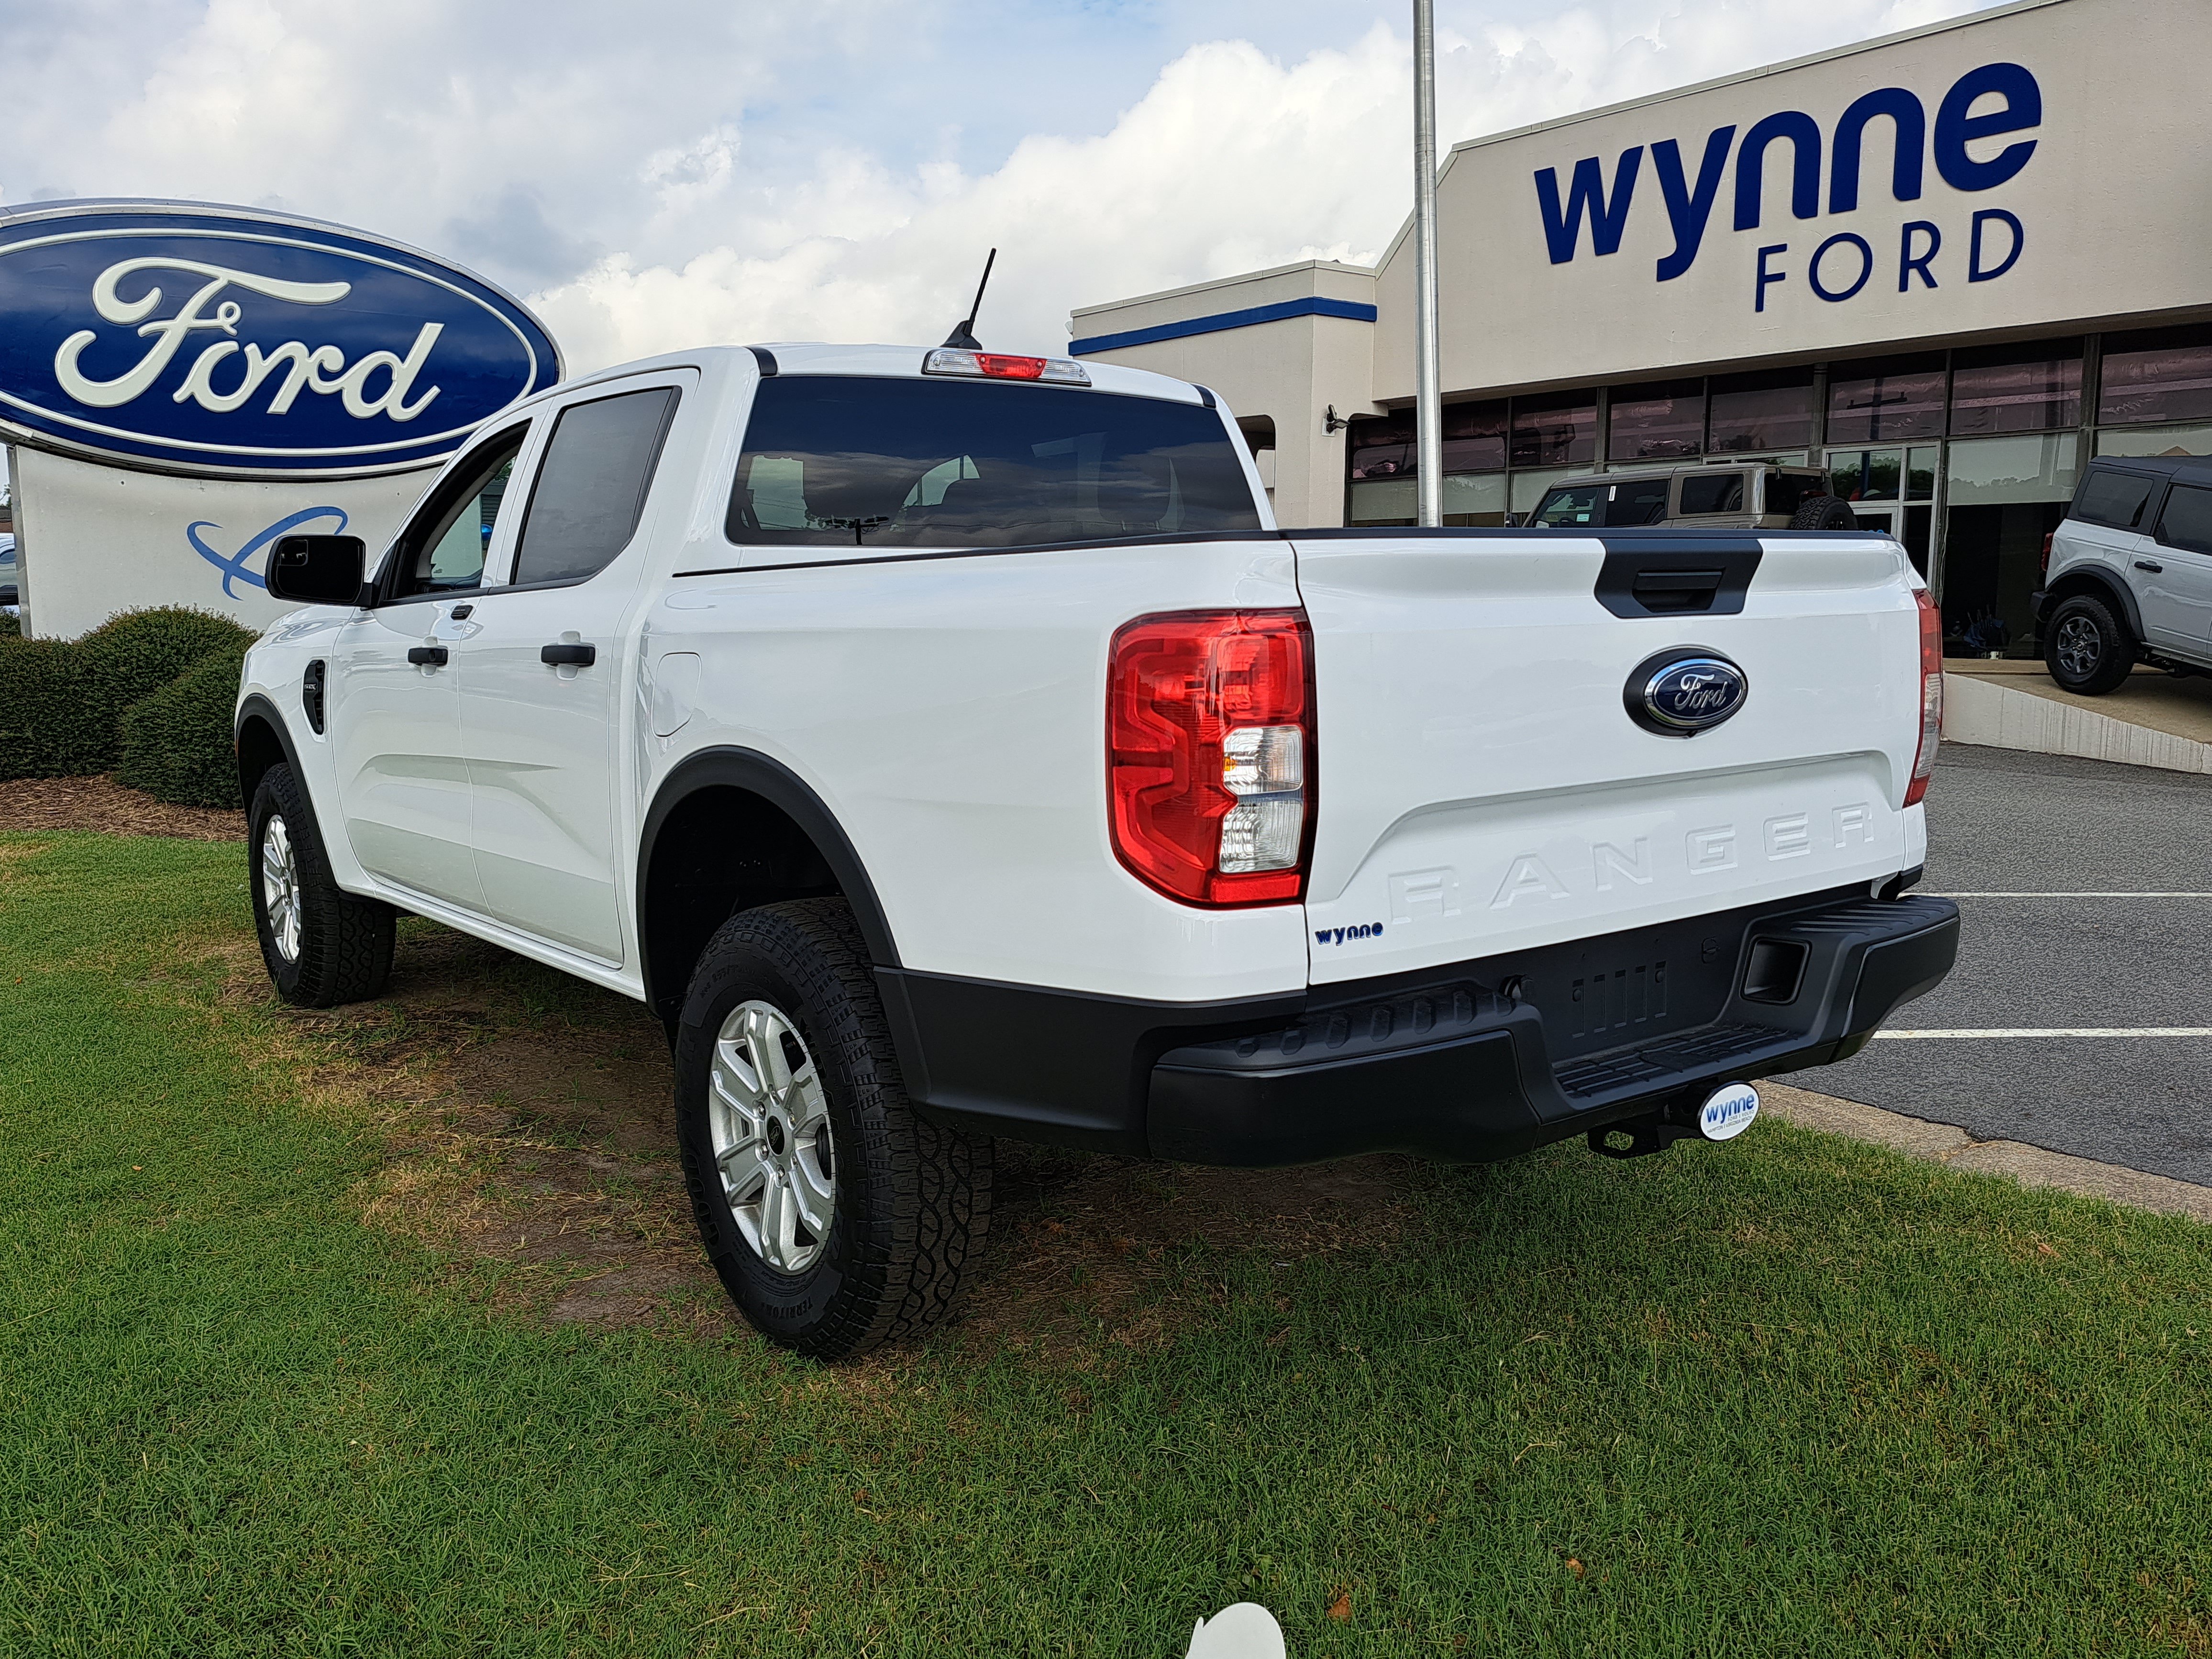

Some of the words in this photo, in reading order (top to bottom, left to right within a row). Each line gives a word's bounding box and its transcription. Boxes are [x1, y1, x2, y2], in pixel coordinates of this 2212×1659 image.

[1534, 62, 2042, 282] wynne
[1755, 208, 2024, 312] FORD
[55, 257, 445, 421] Ford
[1675, 674, 1728, 711] Ford
[1388, 802, 1875, 925] RANGER
[1315, 922, 1383, 946] wynne
[1706, 1094, 1754, 1124] wynne
